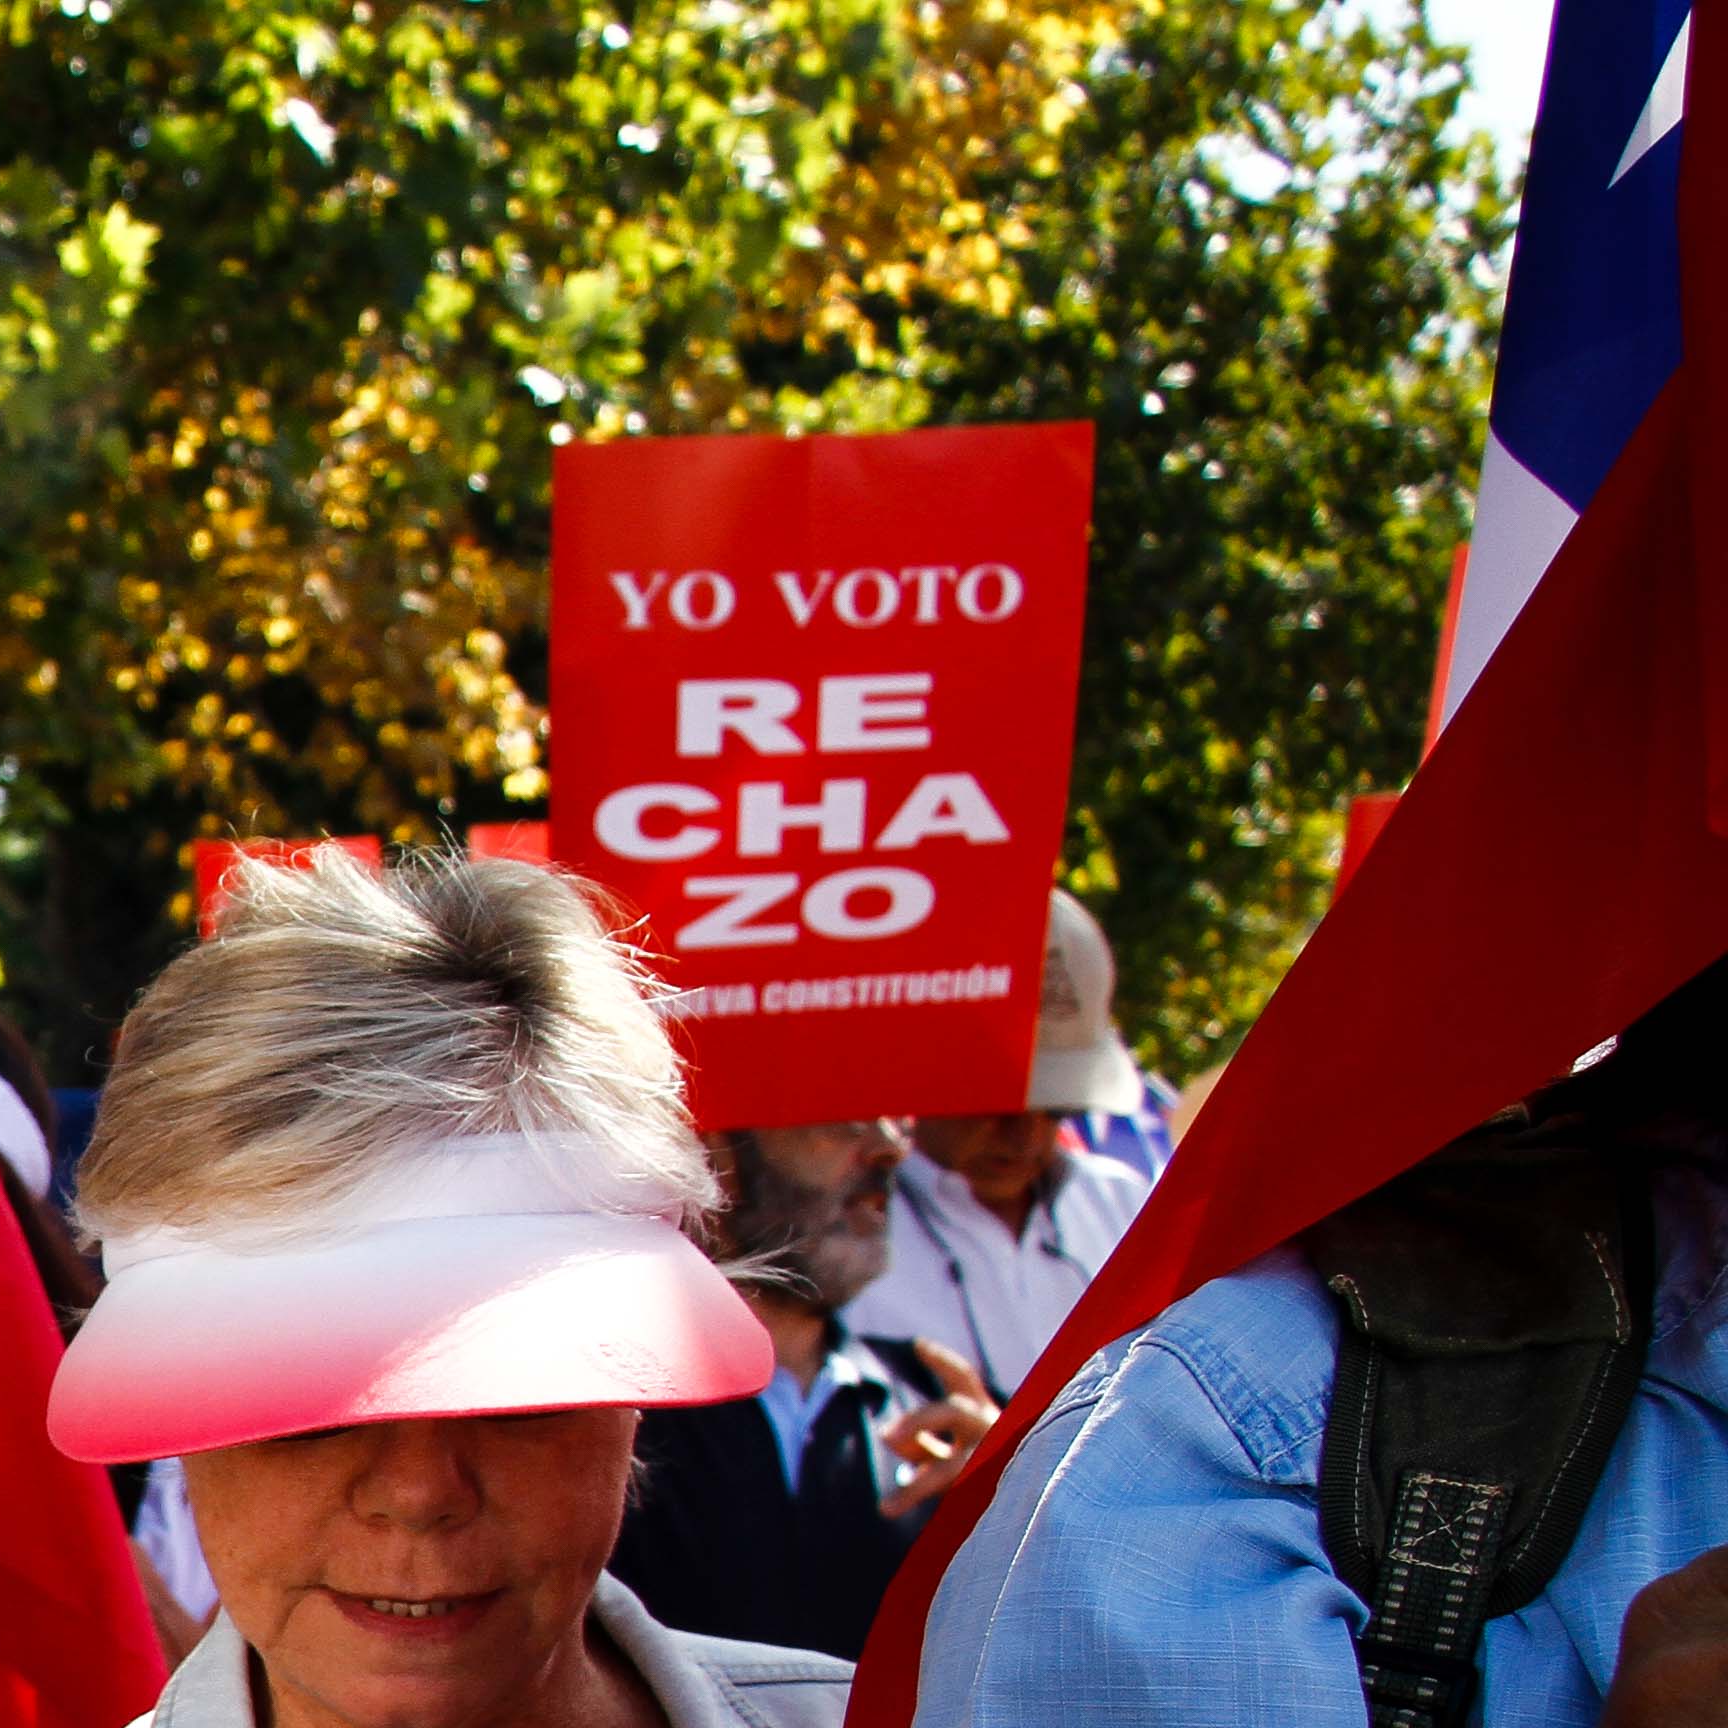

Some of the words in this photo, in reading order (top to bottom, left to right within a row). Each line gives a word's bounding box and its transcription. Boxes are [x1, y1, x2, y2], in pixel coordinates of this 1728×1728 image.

[609, 570, 738, 630] YO
[773, 563, 1024, 628] VOTO
[676, 673, 934, 757] RE
[593, 774, 1010, 860] CHA
[675, 867, 935, 949] ZO
[761, 964, 1011, 1014] CONSTITUCIÓN
